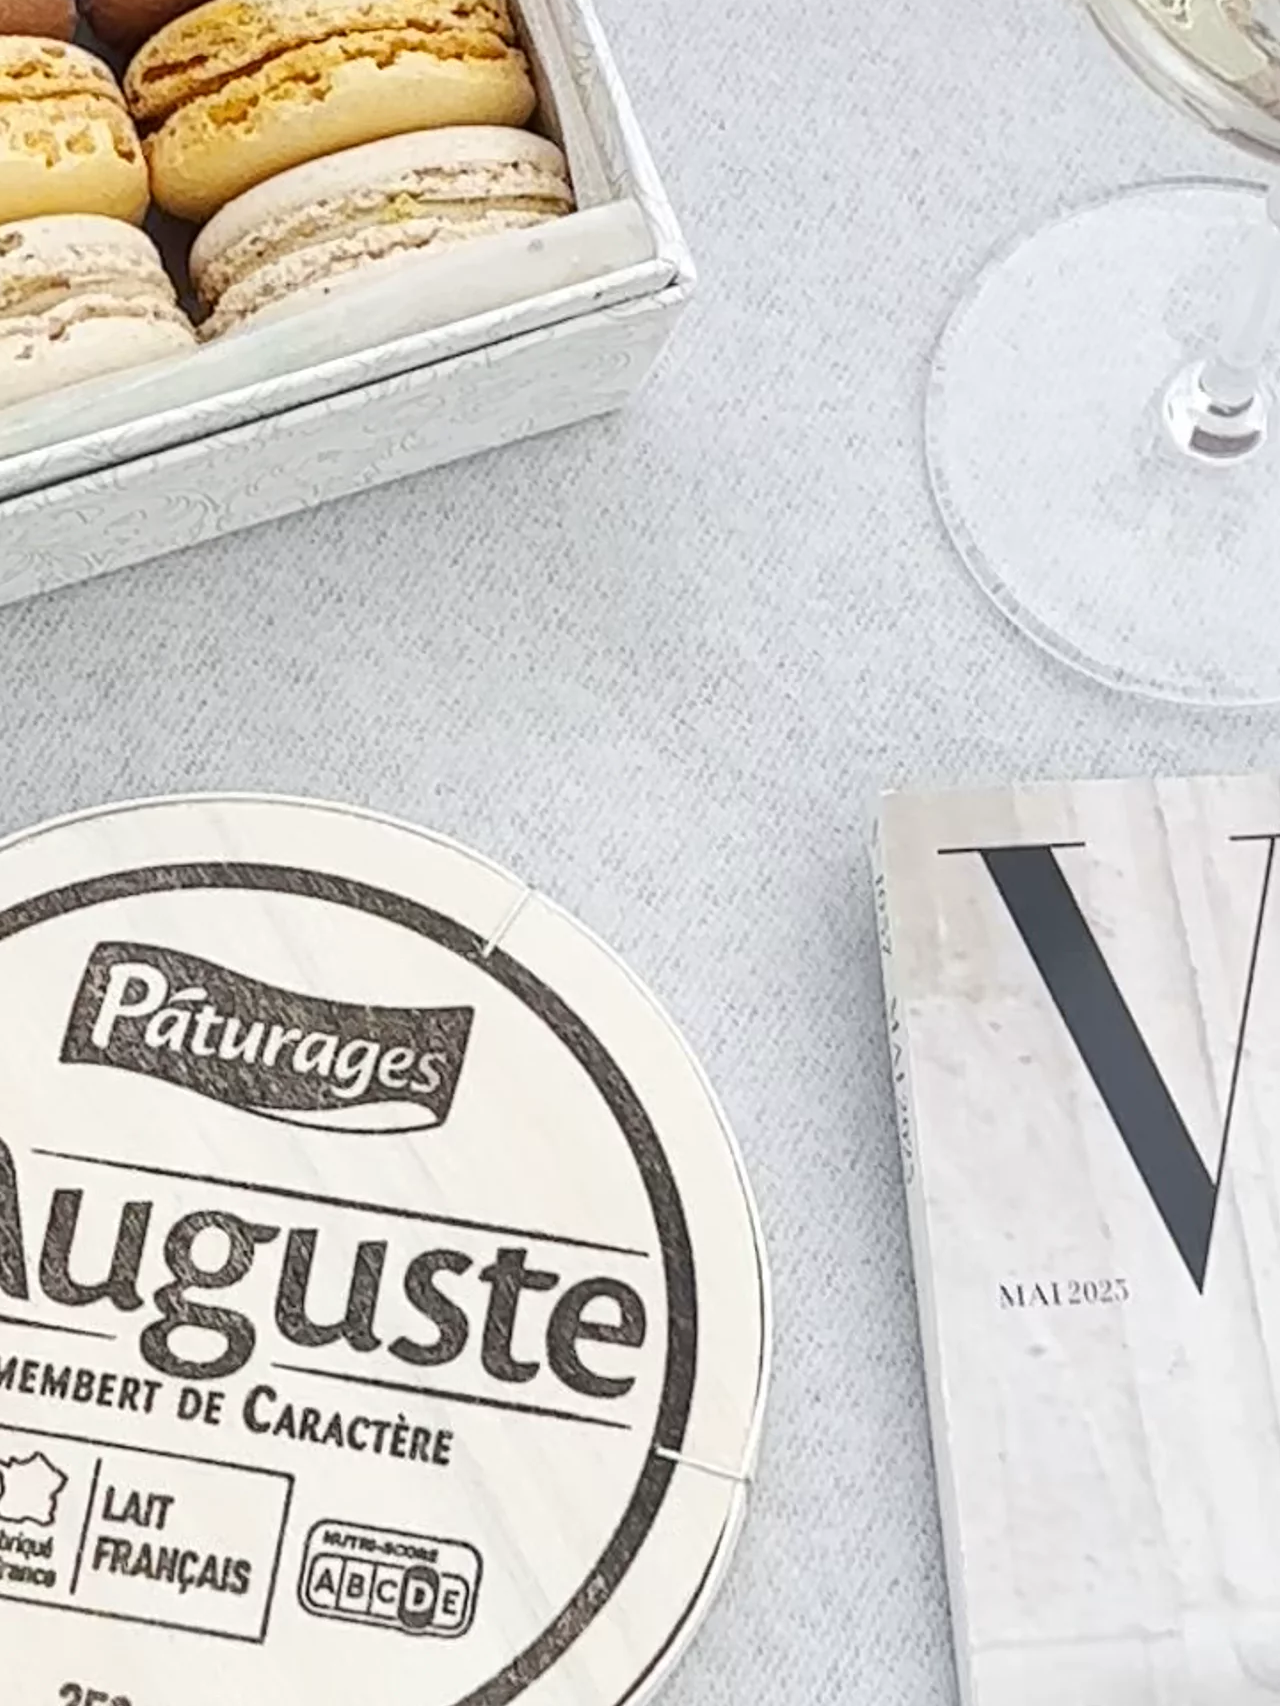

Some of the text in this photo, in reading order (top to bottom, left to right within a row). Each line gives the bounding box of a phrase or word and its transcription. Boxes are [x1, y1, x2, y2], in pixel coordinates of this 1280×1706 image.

[998, 1281, 1062, 1309] MAI
[242, 1385, 455, 1468] CARACTÈRE
[101, 1485, 175, 1530] LAIT
[91, 1536, 252, 1595] FRANÇAIS
[322, 1529, 439, 1564] NUTRI-SCORE
[313, 1567, 460, 1616] A B C D E
